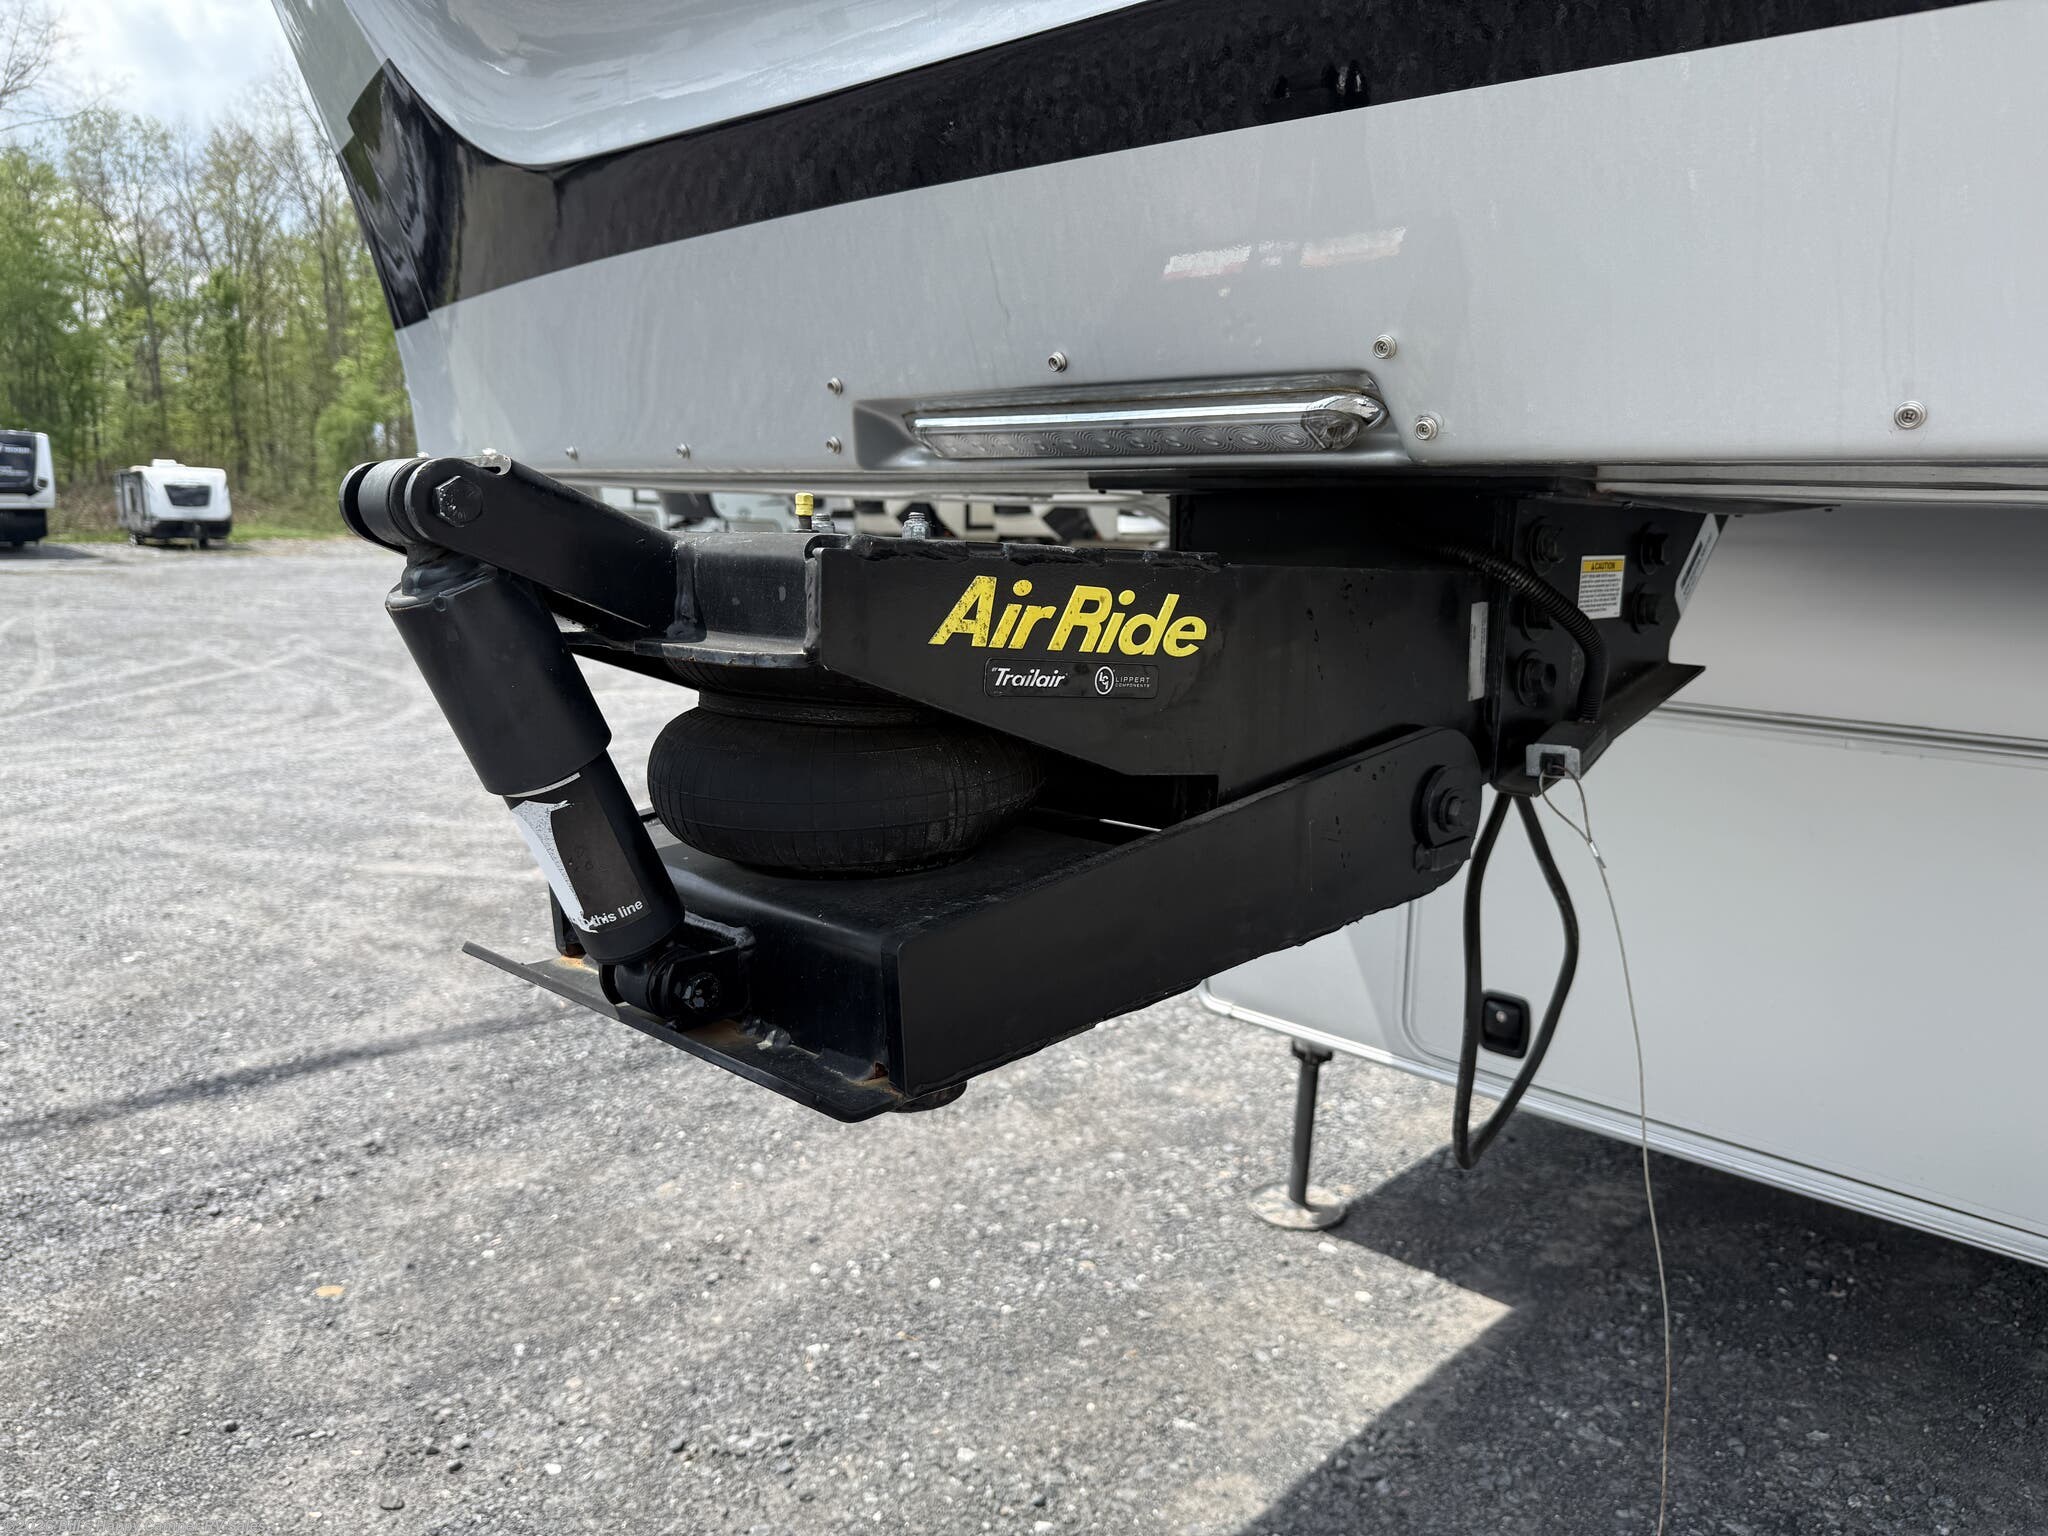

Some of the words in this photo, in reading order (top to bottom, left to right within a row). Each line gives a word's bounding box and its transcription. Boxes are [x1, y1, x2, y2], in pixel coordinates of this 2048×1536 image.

[1594, 562, 1616, 570] CAUTION
[995, 667, 1066, 688] Trailair
[1115, 676, 1150, 684] LIPPERT
[590, 912, 617, 927] this
[617, 900, 643, 918] line
